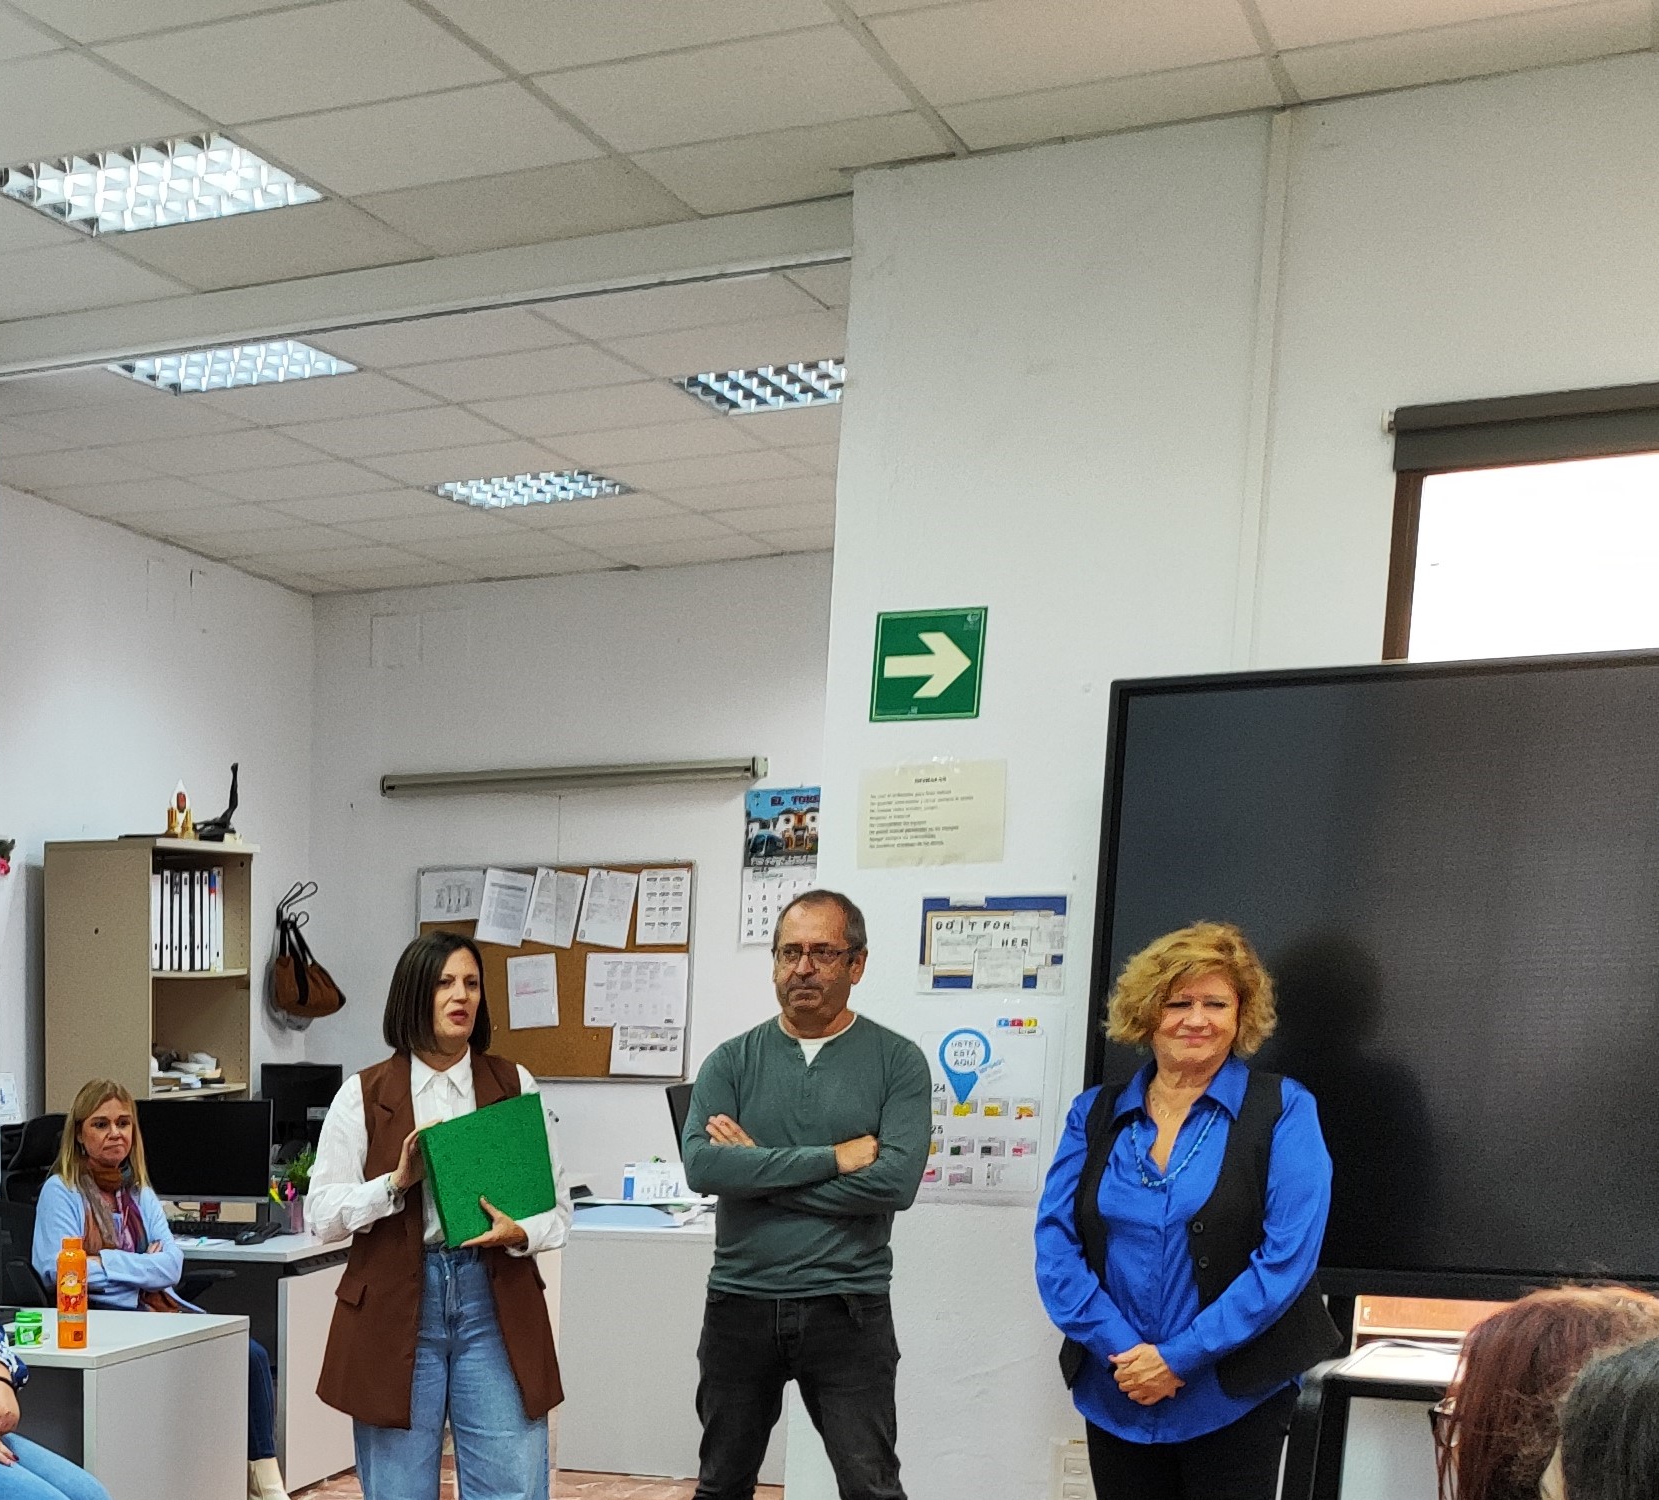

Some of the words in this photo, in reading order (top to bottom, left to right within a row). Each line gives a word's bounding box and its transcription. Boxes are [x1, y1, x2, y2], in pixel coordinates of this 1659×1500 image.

[983, 920, 1011, 931] FOR
[1002, 938, 1029, 947] HER
[951, 1040, 981, 1048] USTED
